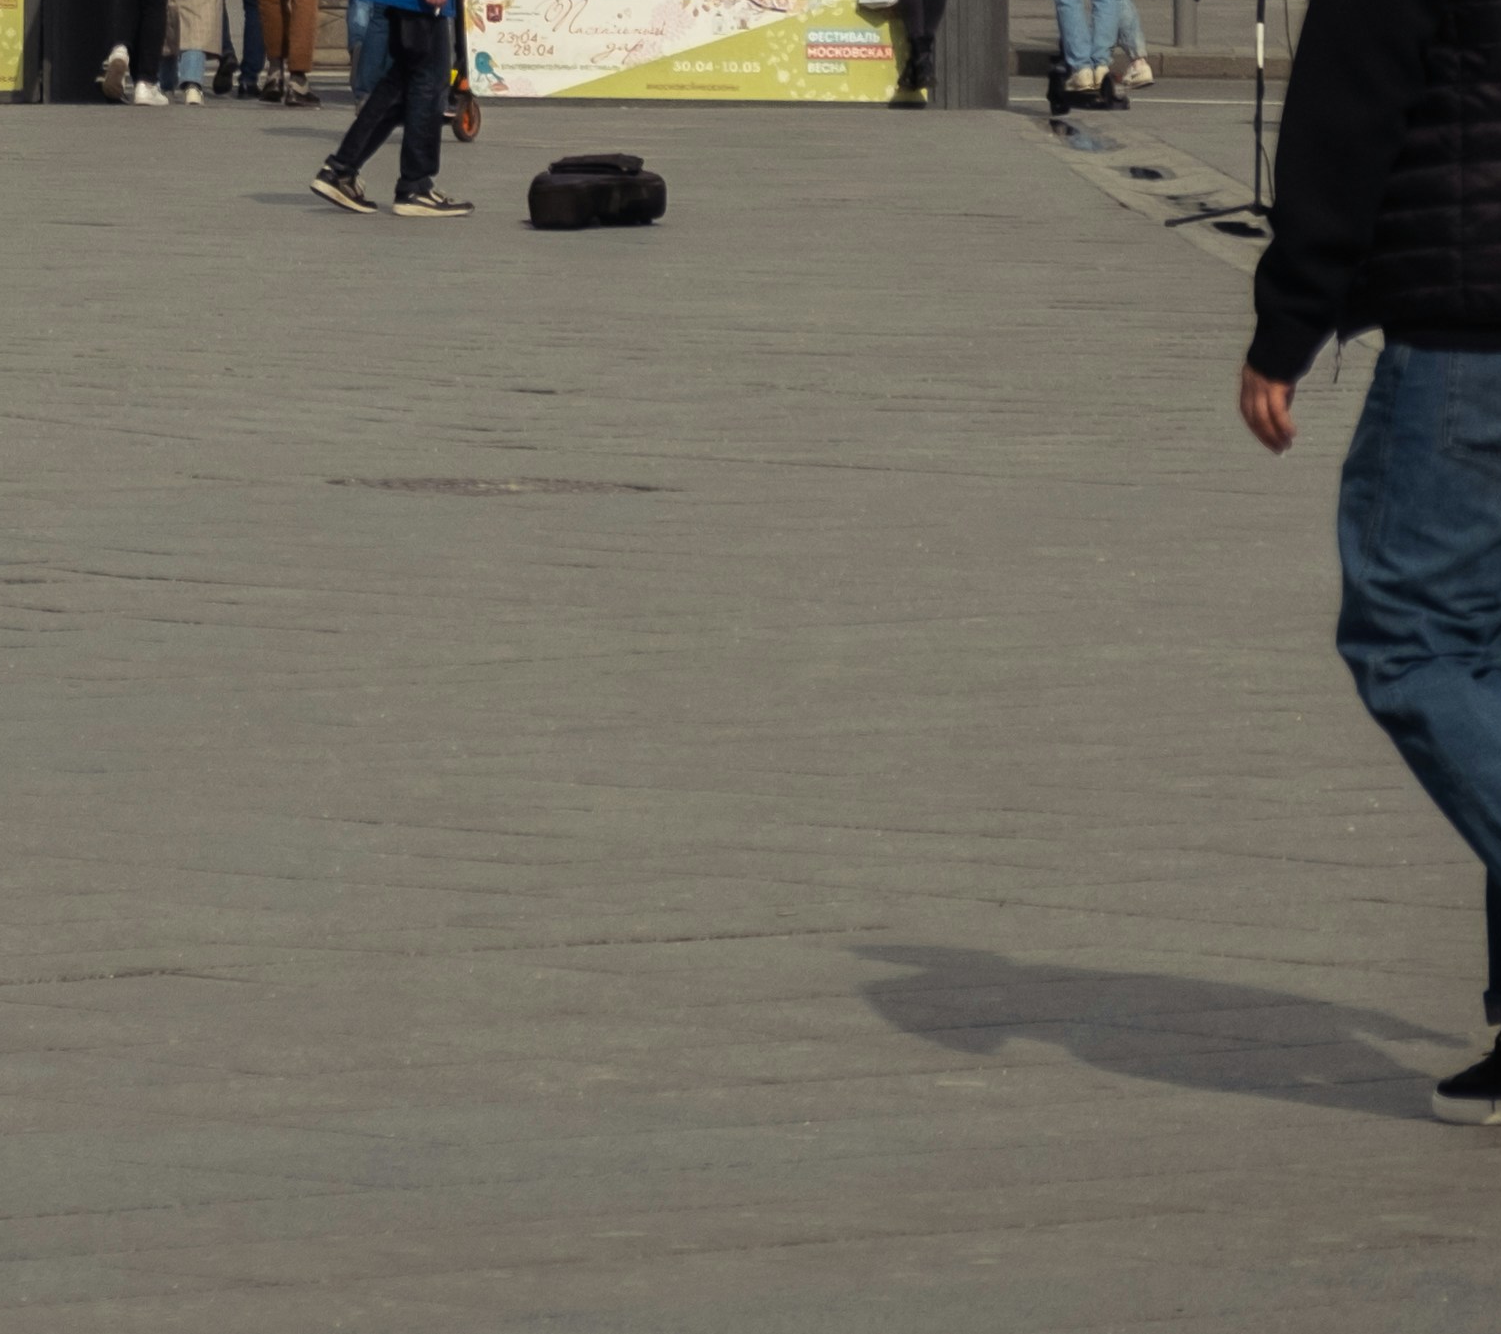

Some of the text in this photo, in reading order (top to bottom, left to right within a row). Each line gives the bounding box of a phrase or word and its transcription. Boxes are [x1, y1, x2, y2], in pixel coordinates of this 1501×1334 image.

[807, 31, 881, 43] ФЕСТИВАЛЬ
[513, 44, 554, 57] 28.04
[807, 46, 892, 59] МОСКОВСКАЯ
[807, 62, 846, 74] ВЕСНА
